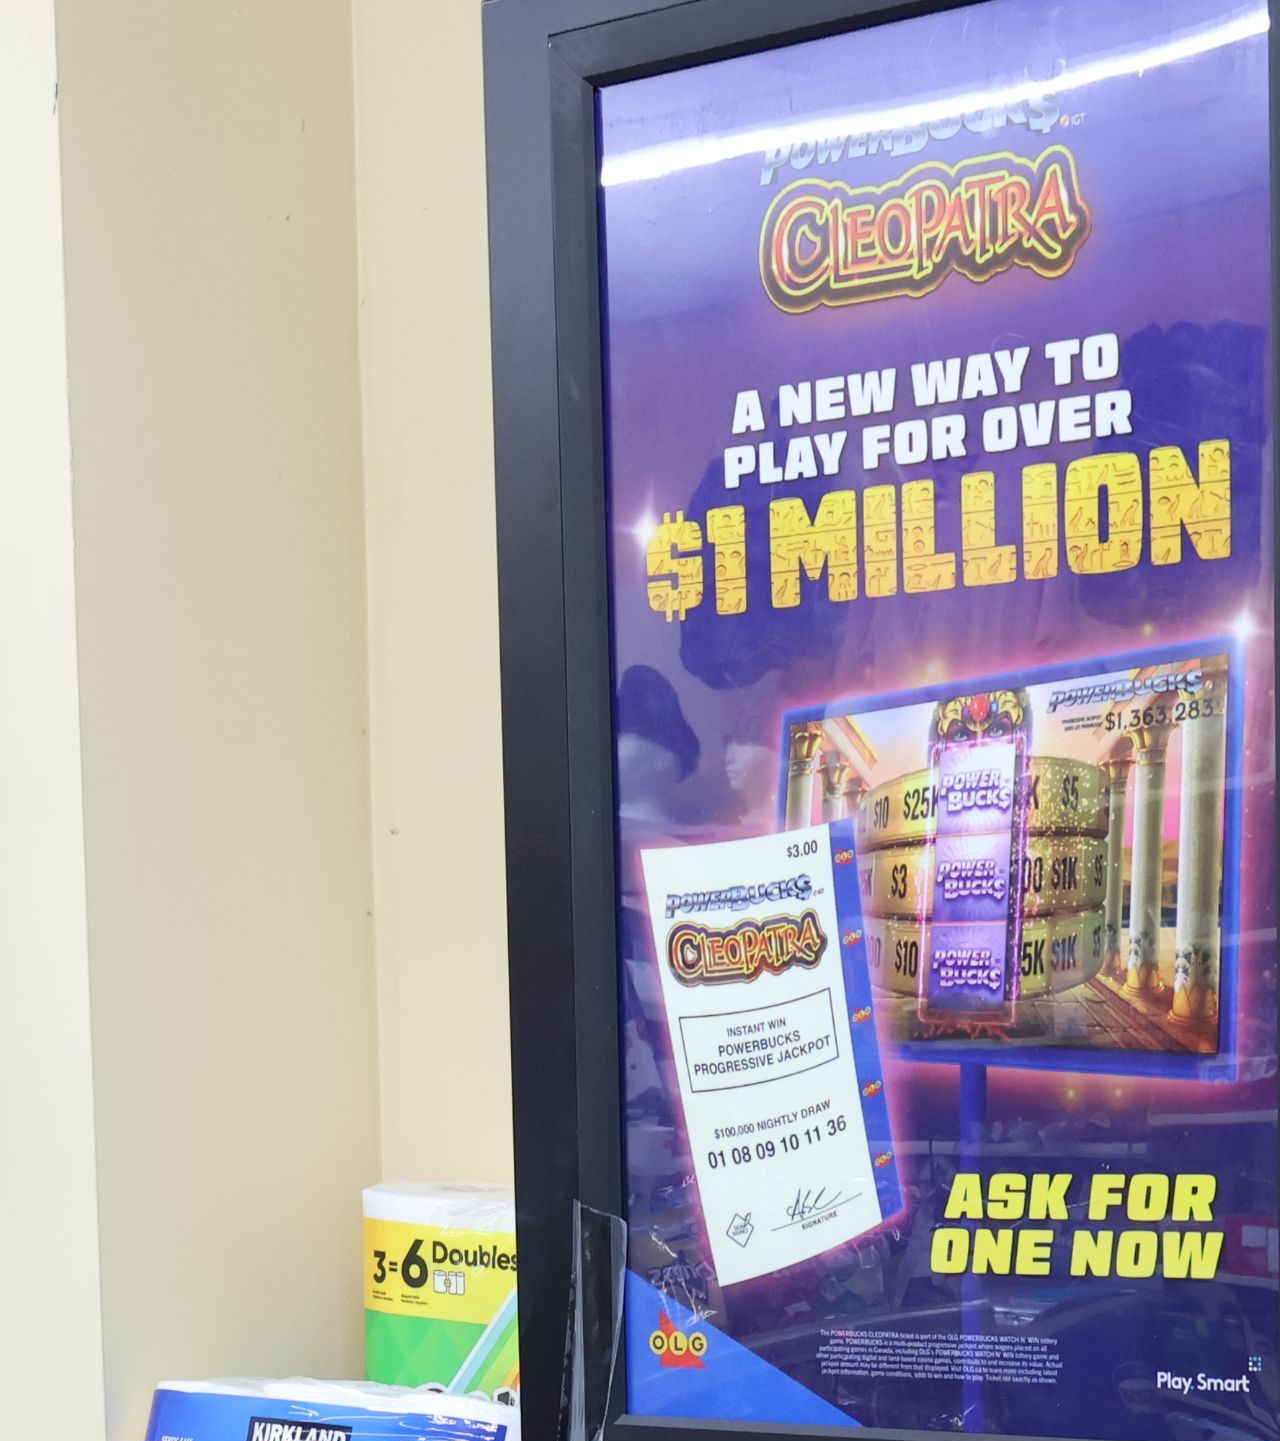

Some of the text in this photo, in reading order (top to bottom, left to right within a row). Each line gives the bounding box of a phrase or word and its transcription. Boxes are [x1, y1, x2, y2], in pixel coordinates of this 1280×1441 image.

[772, 162, 1078, 296] CLEOPATRA
[732, 332, 1120, 434] A NEW WAY TO
[723, 389, 1133, 489] PLAY FOR OVER
[646, 438, 1233, 624] $1 MILLION
[1062, 774, 1079, 808] $5
[787, 839, 818, 859] $3.00
[892, 863, 908, 900] $3
[671, 916, 821, 980] CLEOPATRA
[718, 1030, 801, 1056] POWERBUCKS
[726, 1017, 787, 1038] INSTANT WIN
[694, 1034, 831, 1076] PROGRESSIVE JACKPOT
[714, 1099, 831, 1139] $100,000 NIGHTLY DRAW
[707, 1115, 847, 1169] 01 08 09 10 11 36
[943, 1172, 1217, 1224] ASK FOR
[801, 1210, 838, 1231] SIGNATURE
[930, 1227, 1224, 1281] ONE NOW
[649, 1328, 708, 1358] OLG
[1197, 1373, 1250, 1392] Smart
